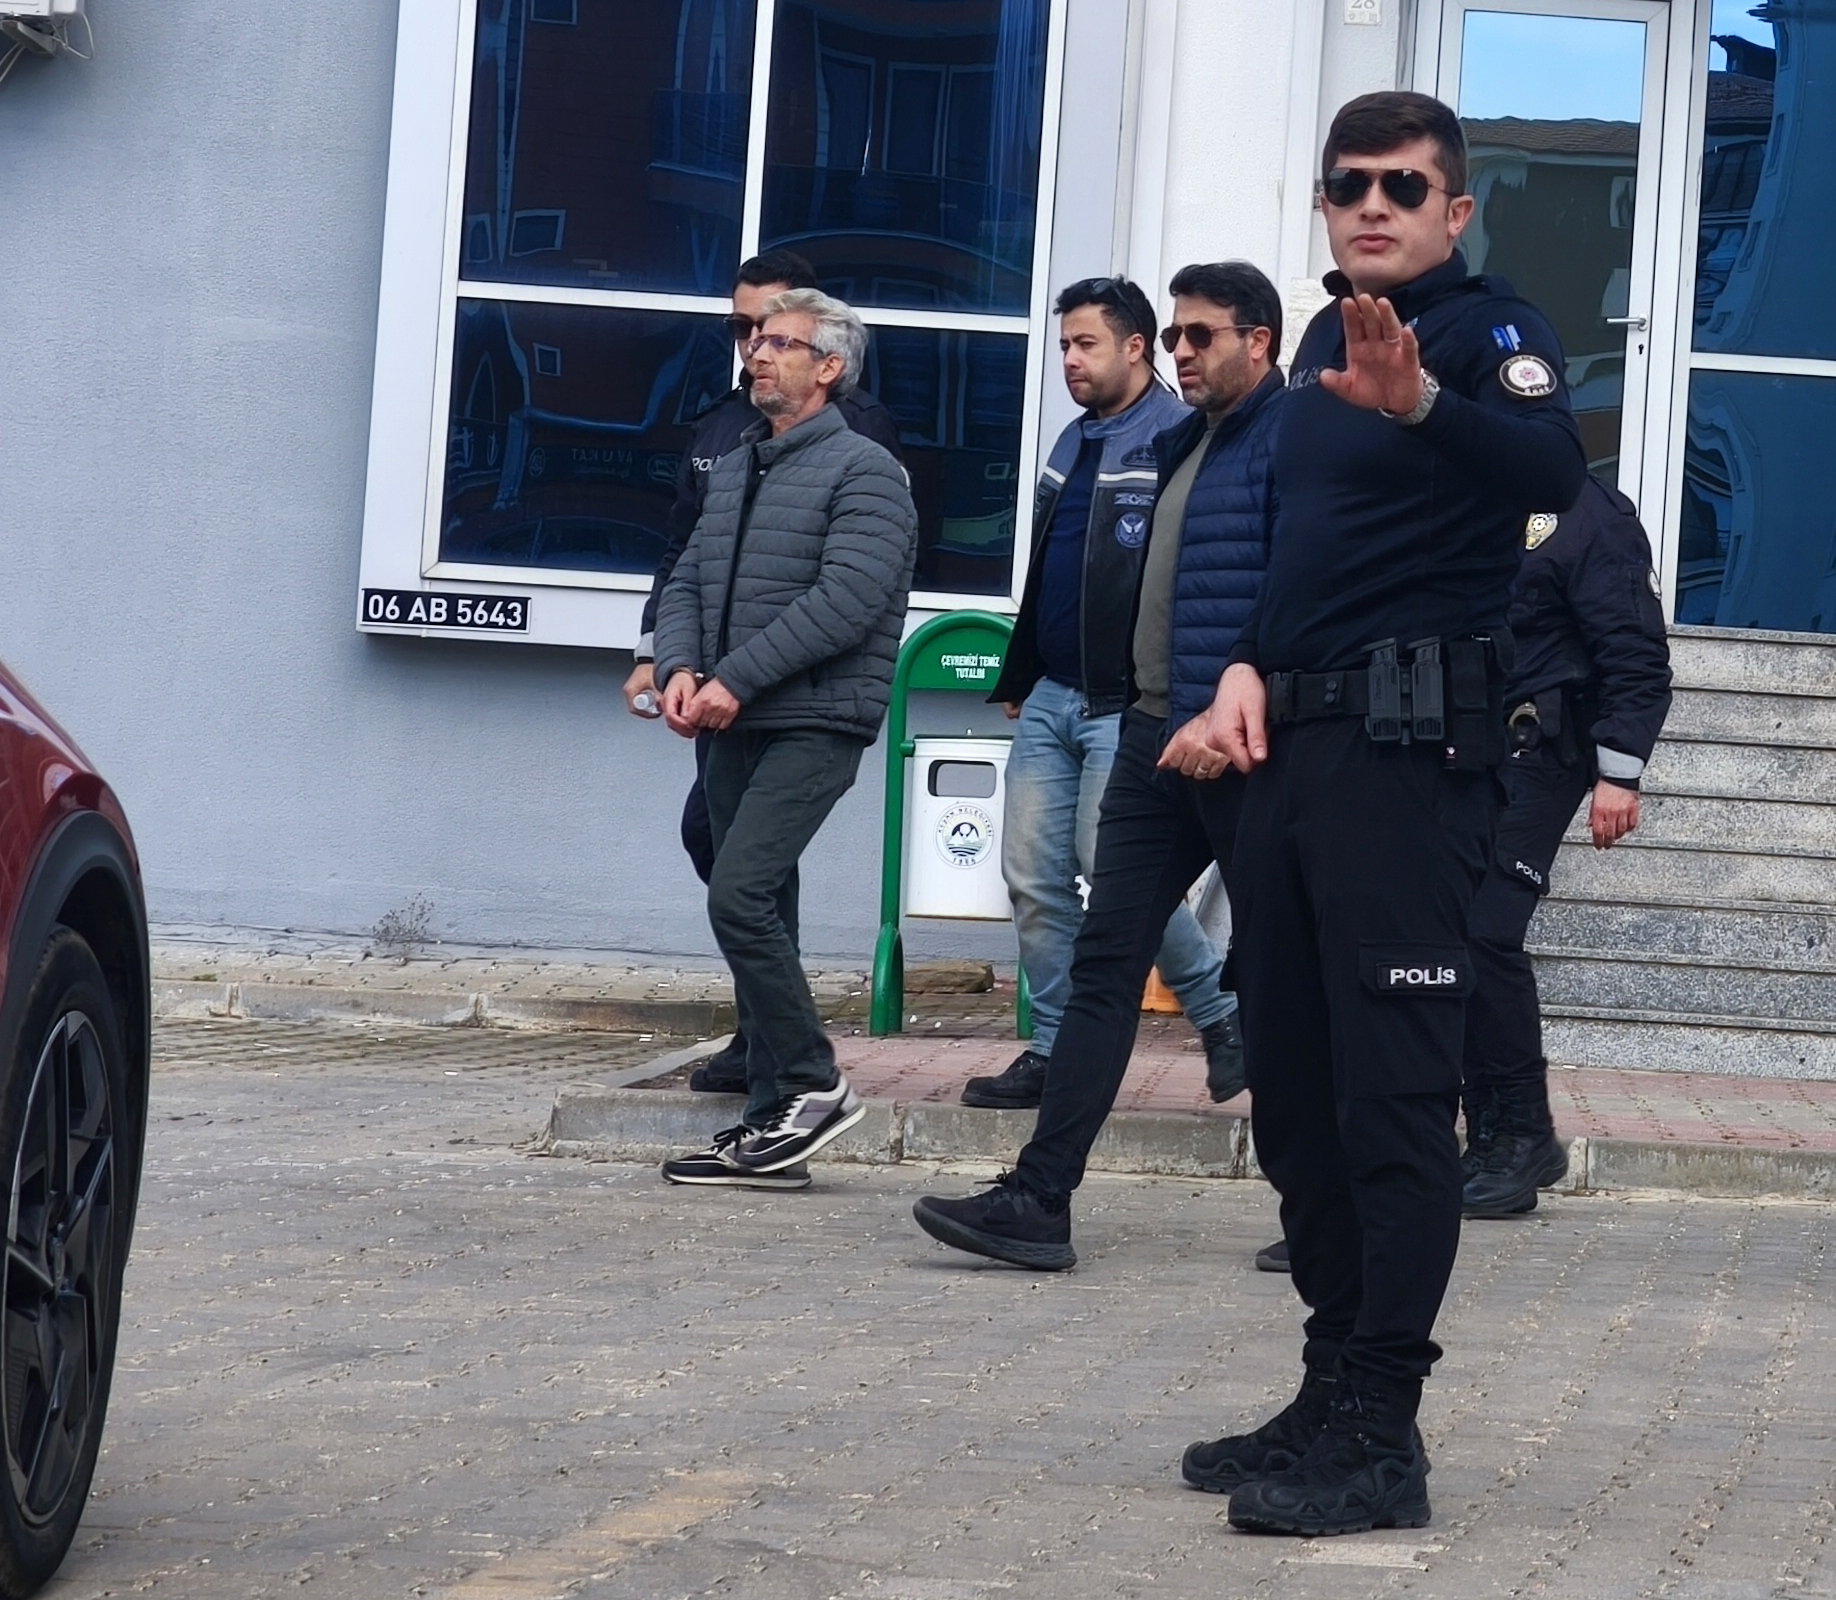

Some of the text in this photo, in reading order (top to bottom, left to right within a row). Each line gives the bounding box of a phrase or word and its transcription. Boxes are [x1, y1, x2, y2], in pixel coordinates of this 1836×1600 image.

[368, 594, 522, 627] 06 AB 5643
[1515, 860, 1542, 885] POLİS
[1389, 966, 1457, 985] POLİS
